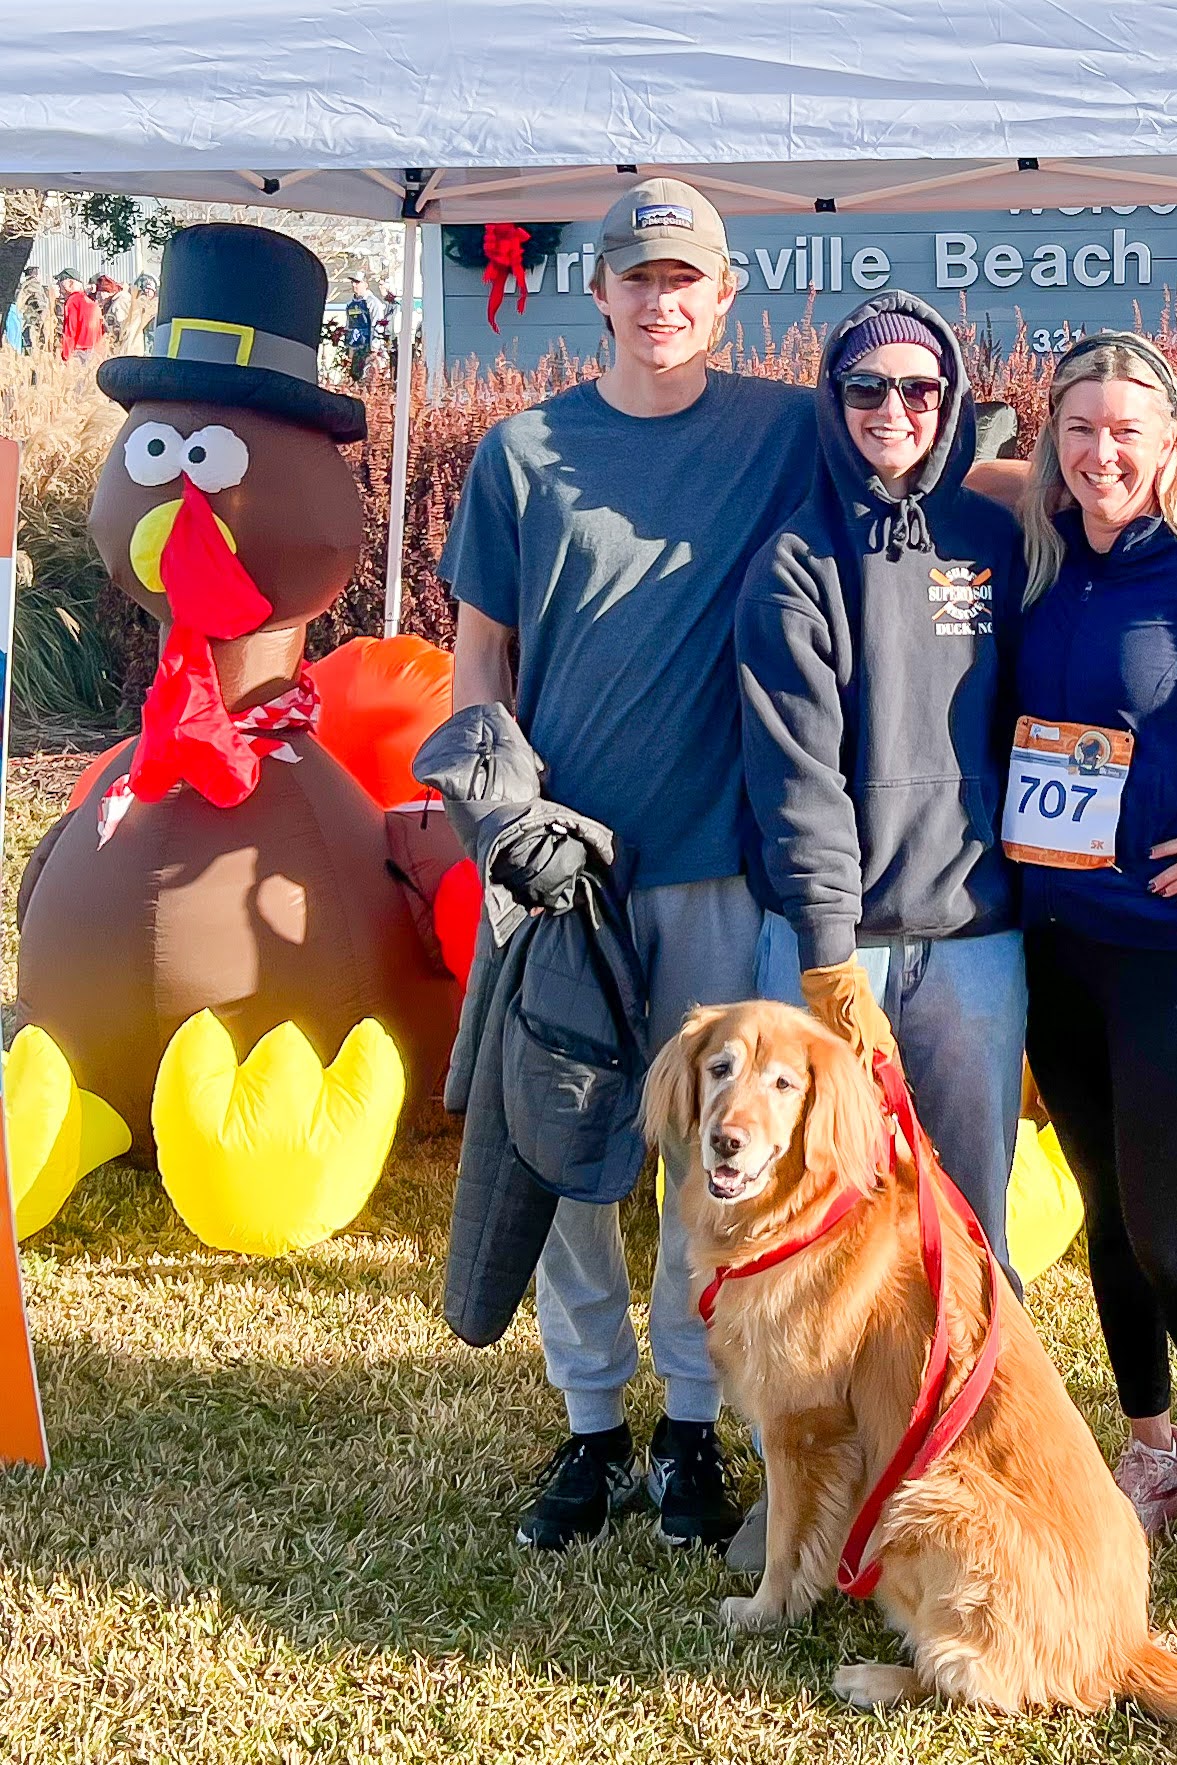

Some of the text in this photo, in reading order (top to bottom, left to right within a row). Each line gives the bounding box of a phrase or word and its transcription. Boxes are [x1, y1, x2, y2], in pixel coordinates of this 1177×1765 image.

[934, 229, 1152, 290] Beach
[1018, 775, 1098, 823] 707
[1090, 839, 1105, 850] 5K
